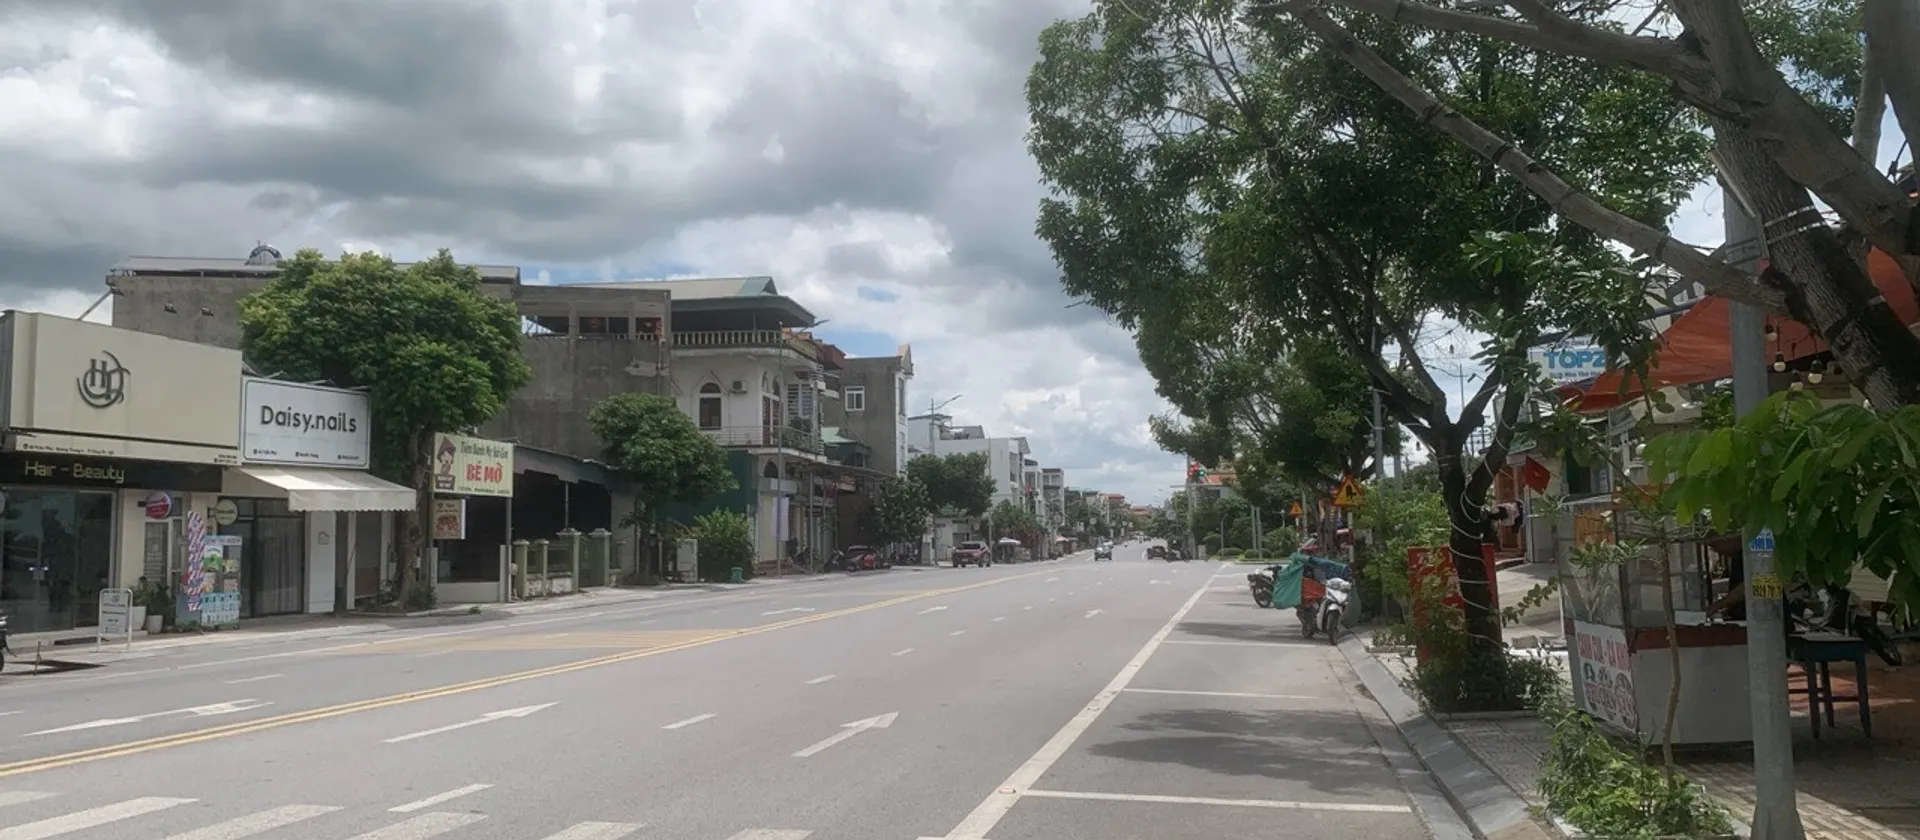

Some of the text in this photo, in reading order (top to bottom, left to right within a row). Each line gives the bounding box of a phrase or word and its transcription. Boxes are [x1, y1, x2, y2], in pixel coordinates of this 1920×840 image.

[260, 405, 357, 434] Daisy.nails
[25, 460, 57, 476] Hair
[73, 463, 125, 484] Beauty
[465, 460, 482, 481] BÉ
